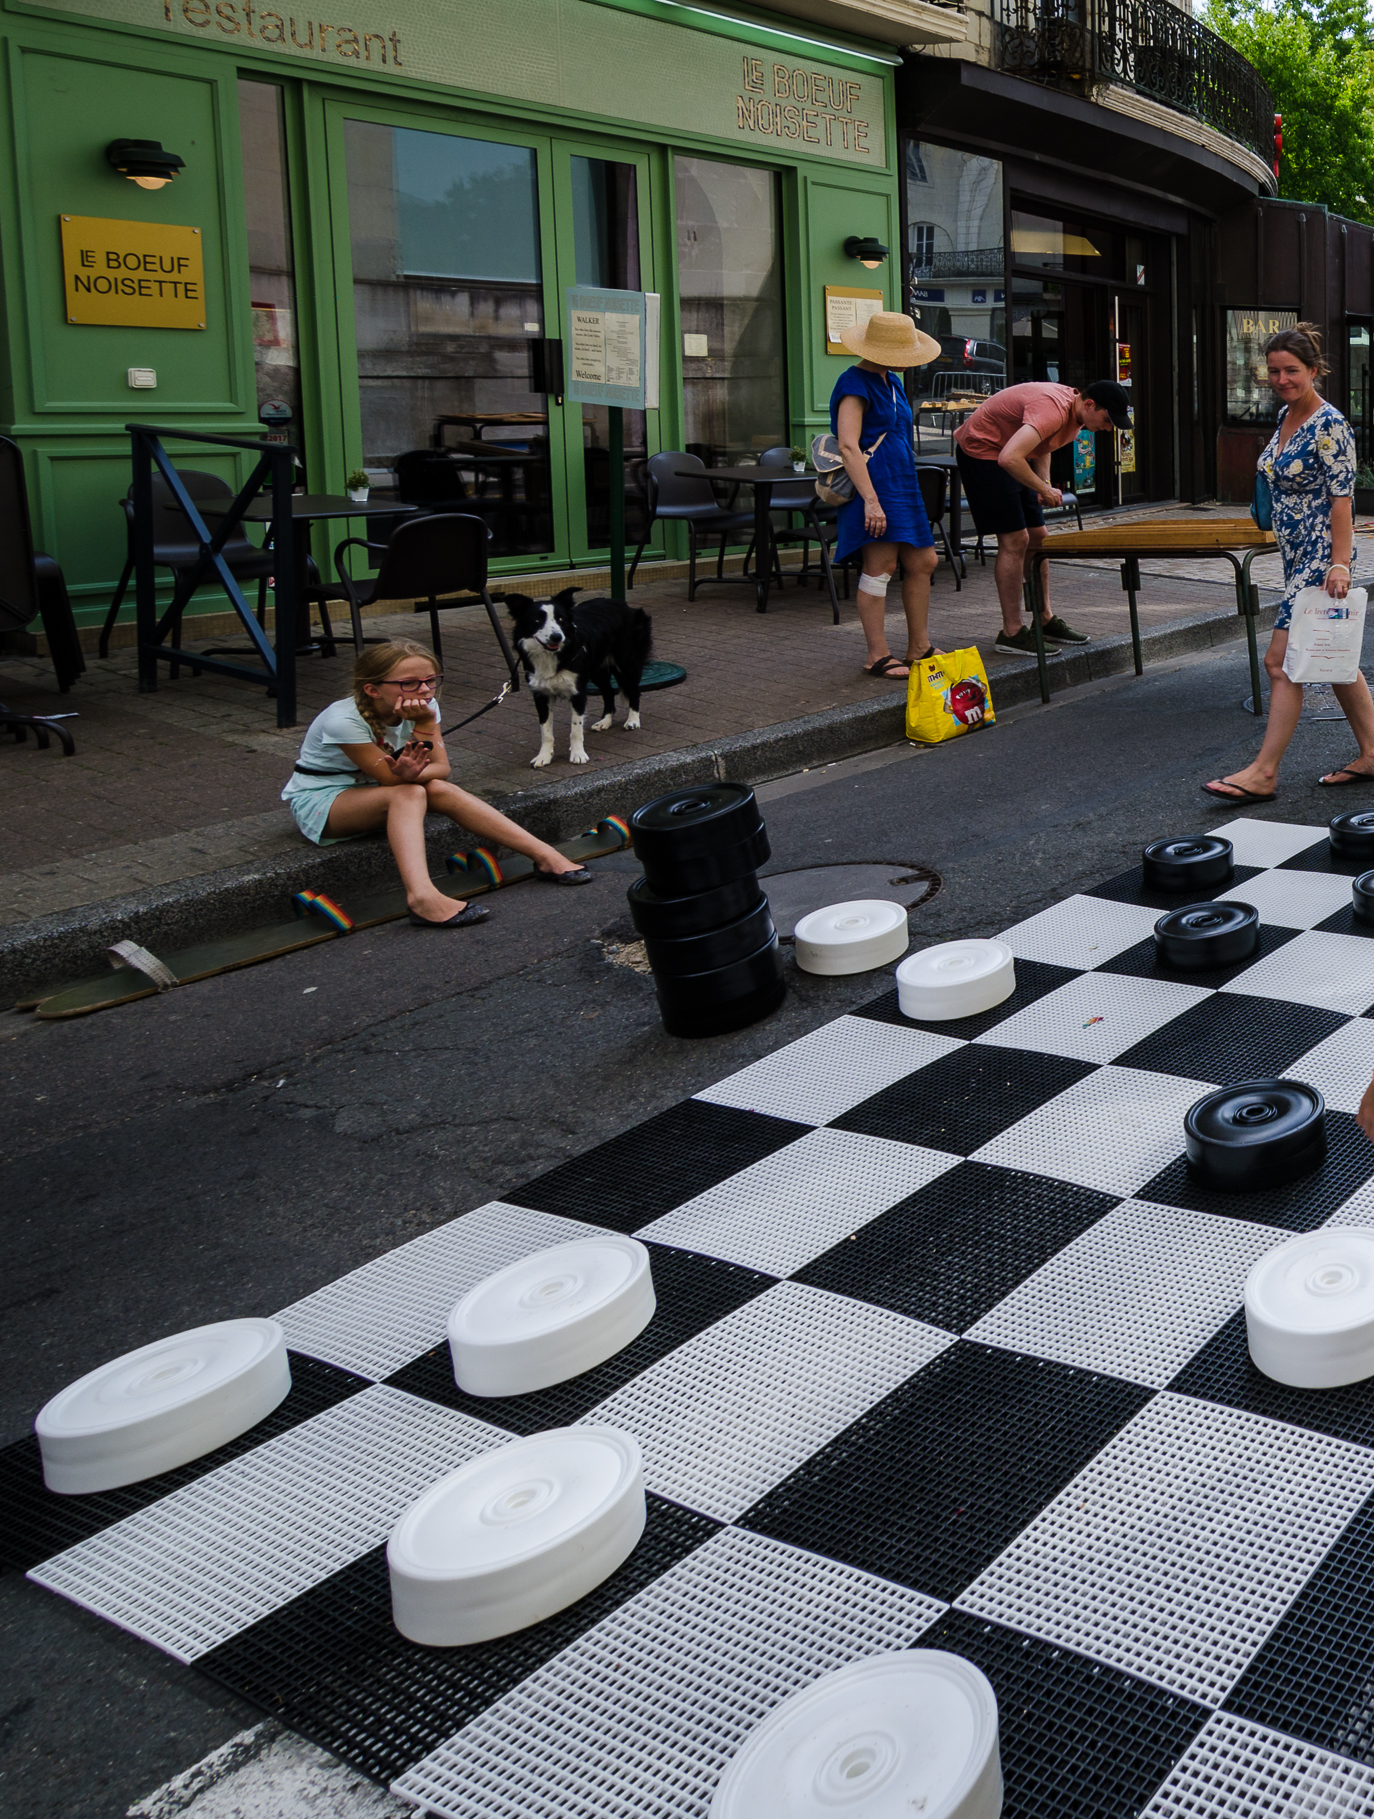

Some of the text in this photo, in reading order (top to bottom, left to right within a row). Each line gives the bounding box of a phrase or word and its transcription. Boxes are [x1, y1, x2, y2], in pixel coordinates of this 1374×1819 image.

[162, 0, 403, 68] restaurant
[742, 55, 862, 114] LE BOEUF
[736, 94, 871, 154] NOISETTE
[80, 249, 190, 275] LE BOEUF
[74, 274, 199, 300] NOISETTE
[576, 315, 600, 325] WALKER
[1242, 318, 1281, 334] BAR
[575, 370, 602, 381] Welcome
[267, 434, 287, 443] 2017
